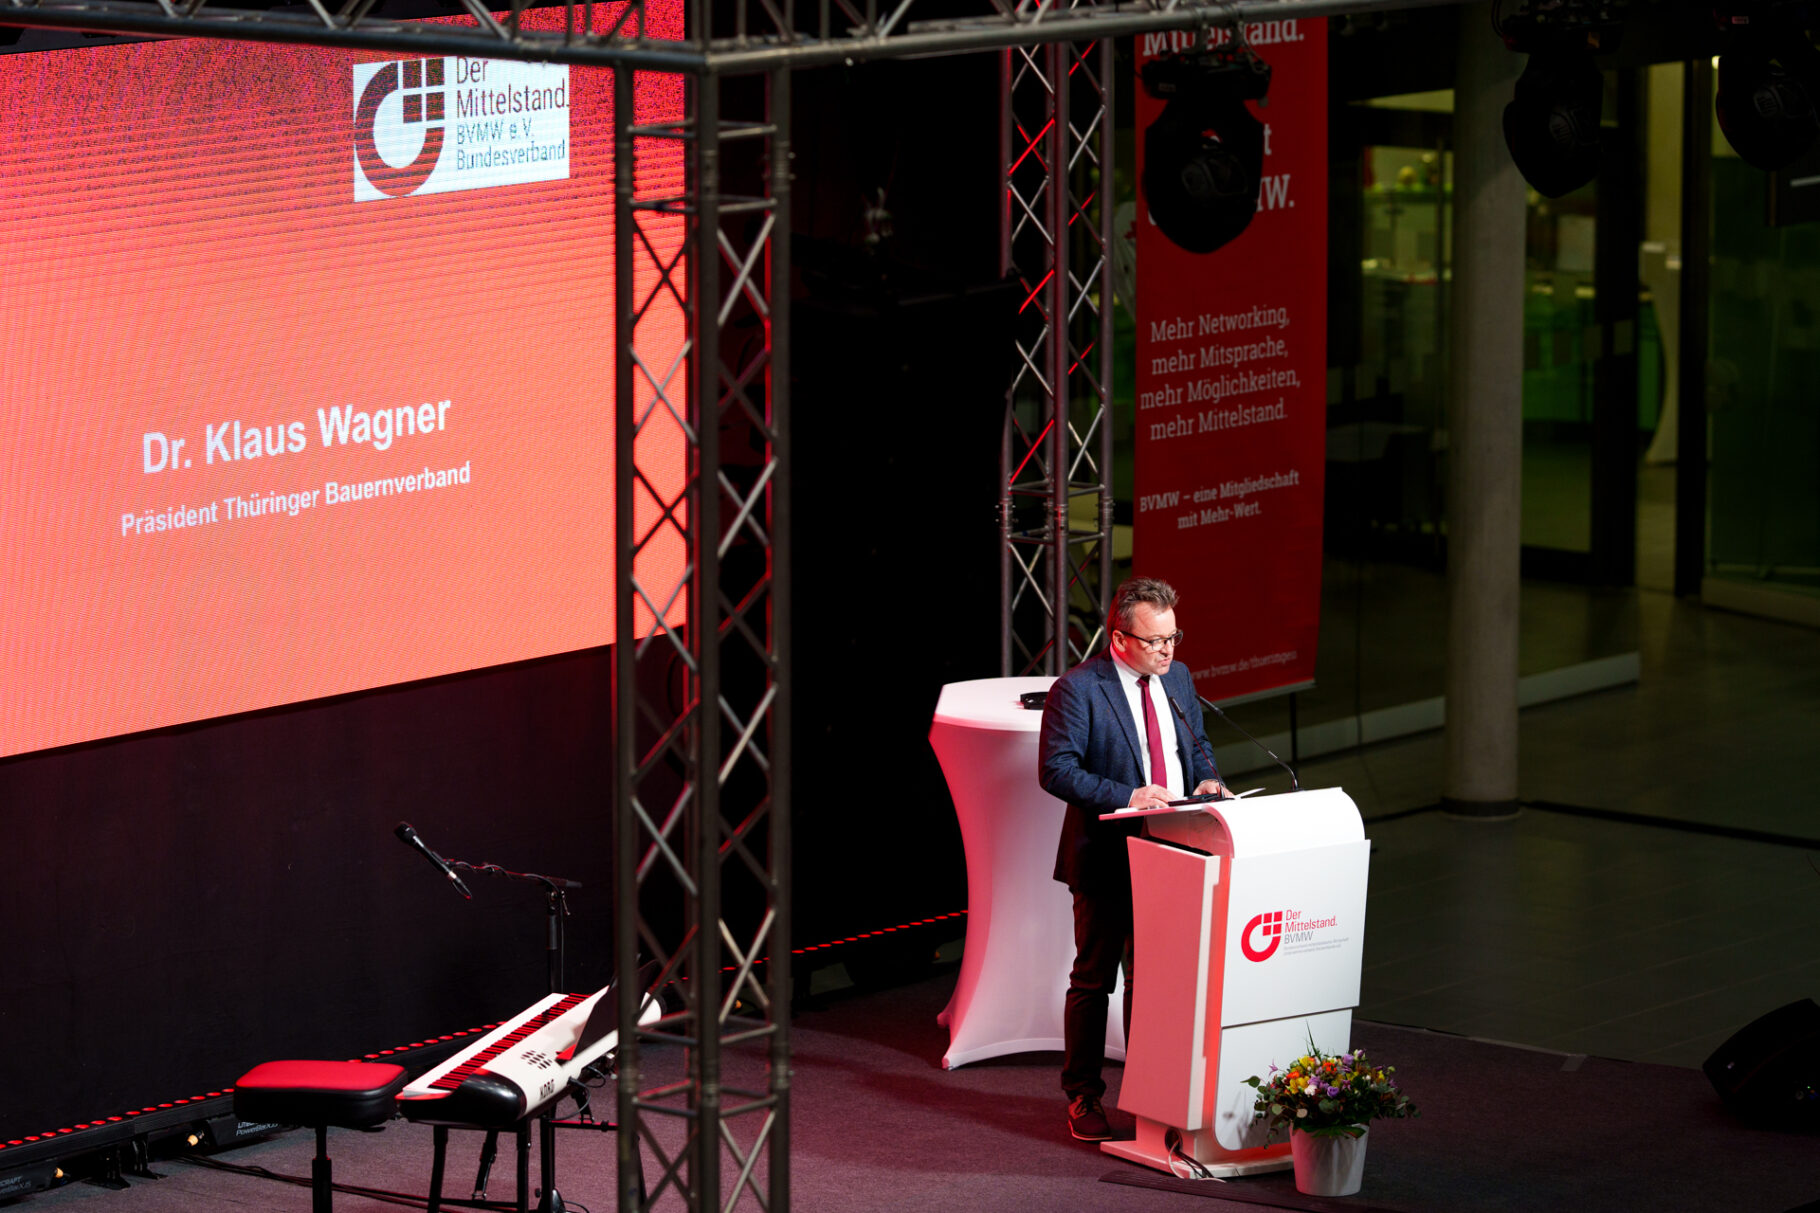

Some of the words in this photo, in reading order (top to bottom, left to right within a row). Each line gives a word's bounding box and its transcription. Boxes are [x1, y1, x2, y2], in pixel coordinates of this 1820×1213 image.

[456, 55, 488, 84] Der
[456, 78, 569, 119] Mittelstand.
[457, 120, 504, 145] BVMW
[457, 139, 565, 170] Bundesverband
[1150, 316, 1195, 343] Mehr
[1198, 304, 1290, 336] Networking,
[1152, 349, 1196, 375] mehr
[1200, 335, 1289, 368] Mitsprache,
[1140, 384, 1183, 410] mehr
[1187, 367, 1301, 404] Möglichkeiten,
[143, 432, 192, 474] Dr.
[205, 420, 307, 465] Klaus
[317, 400, 451, 451] Wagner
[1150, 414, 1195, 441] mehr
[1198, 397, 1288, 433] Mittelstand.
[121, 501, 219, 536] Präsident
[223, 487, 320, 521] Thüringer
[325, 461, 471, 505] Bauernverband
[1139, 491, 1180, 513] BVMW
[1193, 486, 1217, 504] eine
[1219, 469, 1299, 499] Mitgliedschaft
[1177, 511, 1198, 530] mit
[1200, 501, 1262, 526] Mehr-Wert.
[1284, 915, 1338, 933] Mittelstand.
[1285, 909, 1302, 921] Der
[1284, 931, 1314, 944] BVMW
